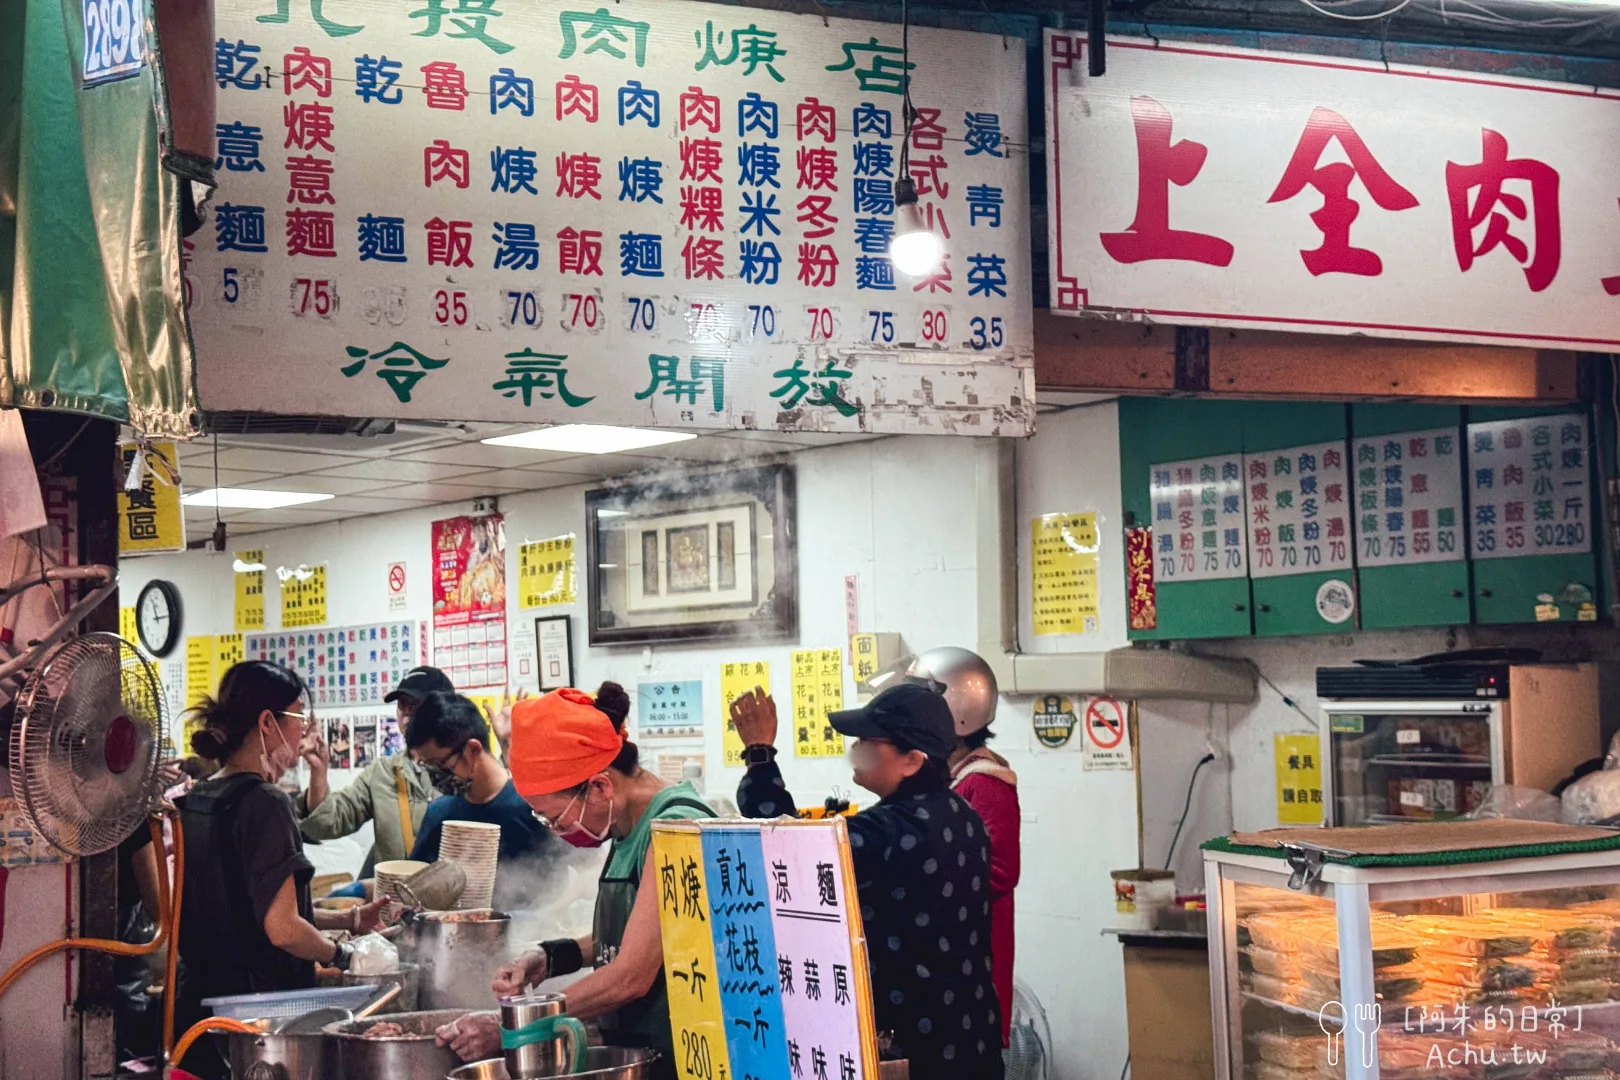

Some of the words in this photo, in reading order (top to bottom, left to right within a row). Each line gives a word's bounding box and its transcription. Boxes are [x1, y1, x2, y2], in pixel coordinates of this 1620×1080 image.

[214, 38, 268, 253] 乾意麵
[283, 46, 337, 258] 肉焿意麵
[354, 54, 408, 263] 乾麵
[420, 61, 474, 268] 魯肉飯
[489, 68, 540, 271] 肉焿湯
[555, 74, 603, 276] 肉焿飯
[617, 80, 664, 278] 肉焿麵
[679, 86, 724, 281] 肉焿粿條
[737, 92, 782, 285] 肉焿米粉
[796, 97, 839, 288] 肉焿冬粉
[852, 102, 897, 291] 肉焿陽春麵
[1099, 94, 1620, 294] 上全肉
[297, 279, 331, 315] 75
[434, 290, 467, 325] 35
[508, 292, 537, 325] 70
[570, 294, 598, 328] 70
[628, 298, 655, 331] 70
[748, 305, 775, 337] 70
[807, 308, 833, 339] 70
[869, 310, 895, 342] 75
[922, 310, 947, 342] 30
[970, 316, 1003, 351] 35
[340, 341, 861, 417] 冷氣開放
[1256, 549, 1274, 568] 70
[1280, 547, 1297, 566] 70
[1304, 546, 1321, 566] 70
[1329, 541, 1346, 562] 70
[857, 636, 872, 677] 面紙
[654, 684, 680, 695] 公告
[660, 853, 705, 922] 肉焿
[716, 848, 754, 897] 貢丸
[772, 859, 838, 907] 涼麵
[724, 922, 764, 976] 花枝
[672, 957, 707, 1002] 一斤
[735, 1006, 769, 1048] 一斤
[778, 953, 803, 1079] 辣味
[803, 958, 828, 1080] 蒜味
[832, 963, 857, 1080] 原味
